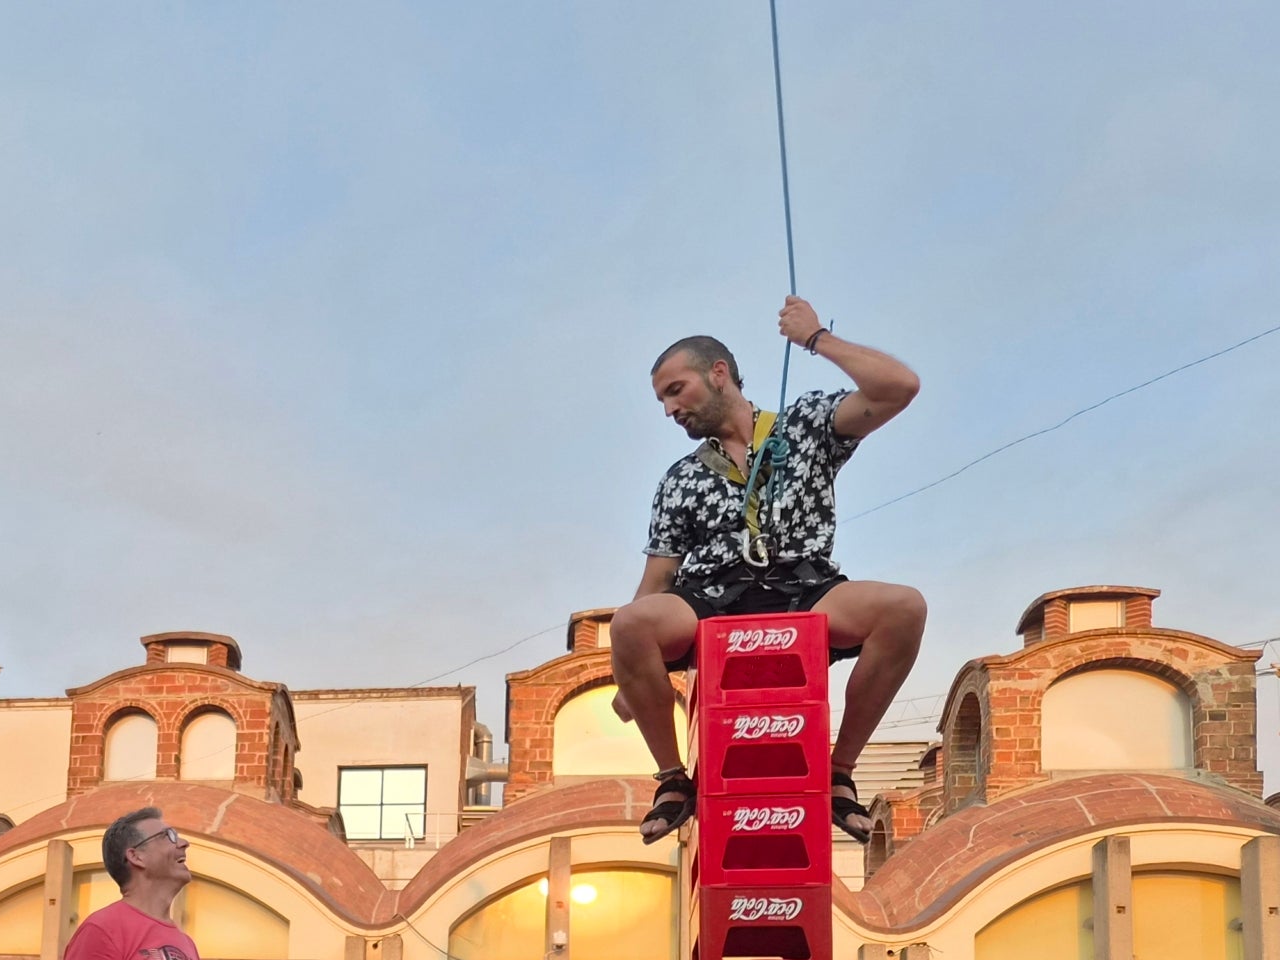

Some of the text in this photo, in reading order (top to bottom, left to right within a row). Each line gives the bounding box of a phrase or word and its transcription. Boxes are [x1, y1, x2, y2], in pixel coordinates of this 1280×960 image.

[727, 627, 797, 652] Coca-Cola
[732, 715, 804, 738] Coca-Cola
[733, 807, 805, 830] Coca-Cola
[729, 898, 802, 920] Coca-Cola
